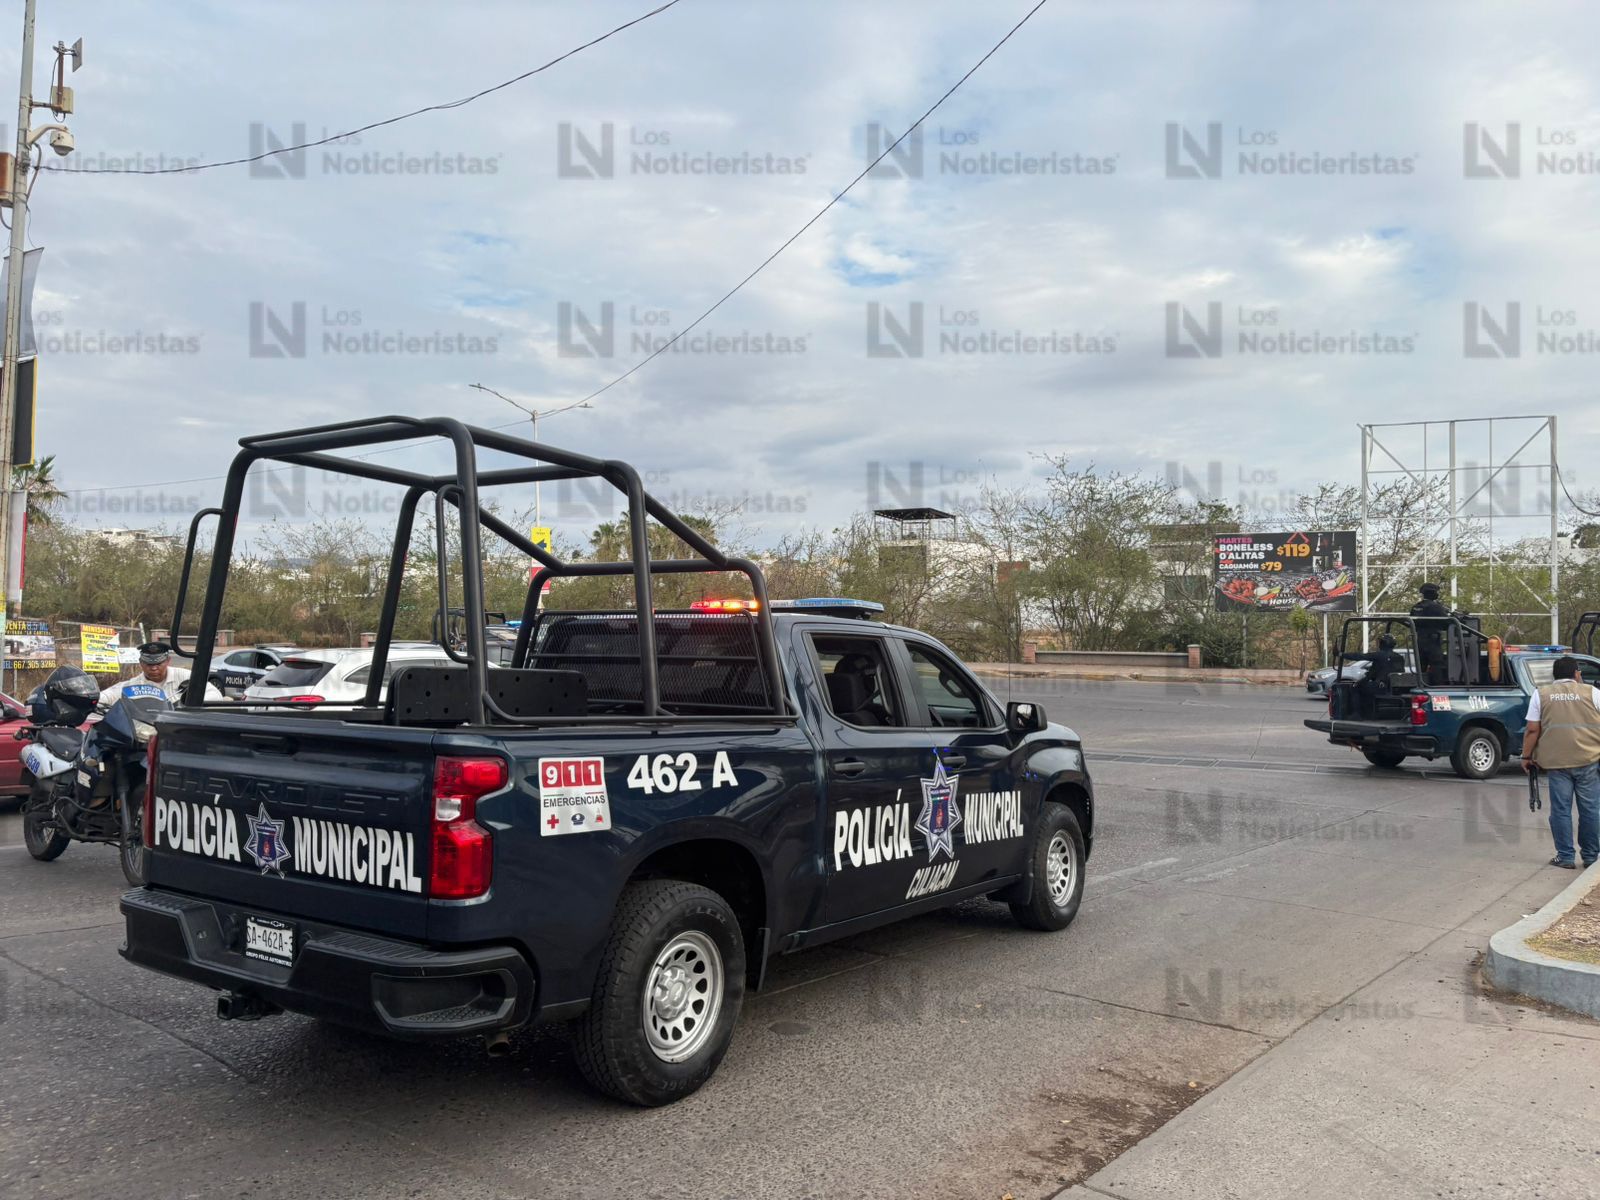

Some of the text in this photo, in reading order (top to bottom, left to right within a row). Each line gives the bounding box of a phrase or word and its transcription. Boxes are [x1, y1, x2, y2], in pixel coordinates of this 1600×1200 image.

[1219, 543, 1274, 552] BONELESS
[1277, 543, 1310, 557] $119
[1228, 551, 1265, 560] ALITAS
[1260, 561, 1282, 571] $79
[82, 625, 114, 634] MINISPLIT
[13, 660, 25, 669] 667
[27, 660, 40, 669] 305
[1550, 693, 1580, 701] PRENSA
[544, 763, 598, 786] 911
[627, 751, 738, 795] 462 A
[543, 795, 606, 808] EMERGENCIAS
[834, 788, 1024, 871] POLICÍA MUNICIPAL
[154, 793, 422, 893] POLICÍA MUNICIPAL
